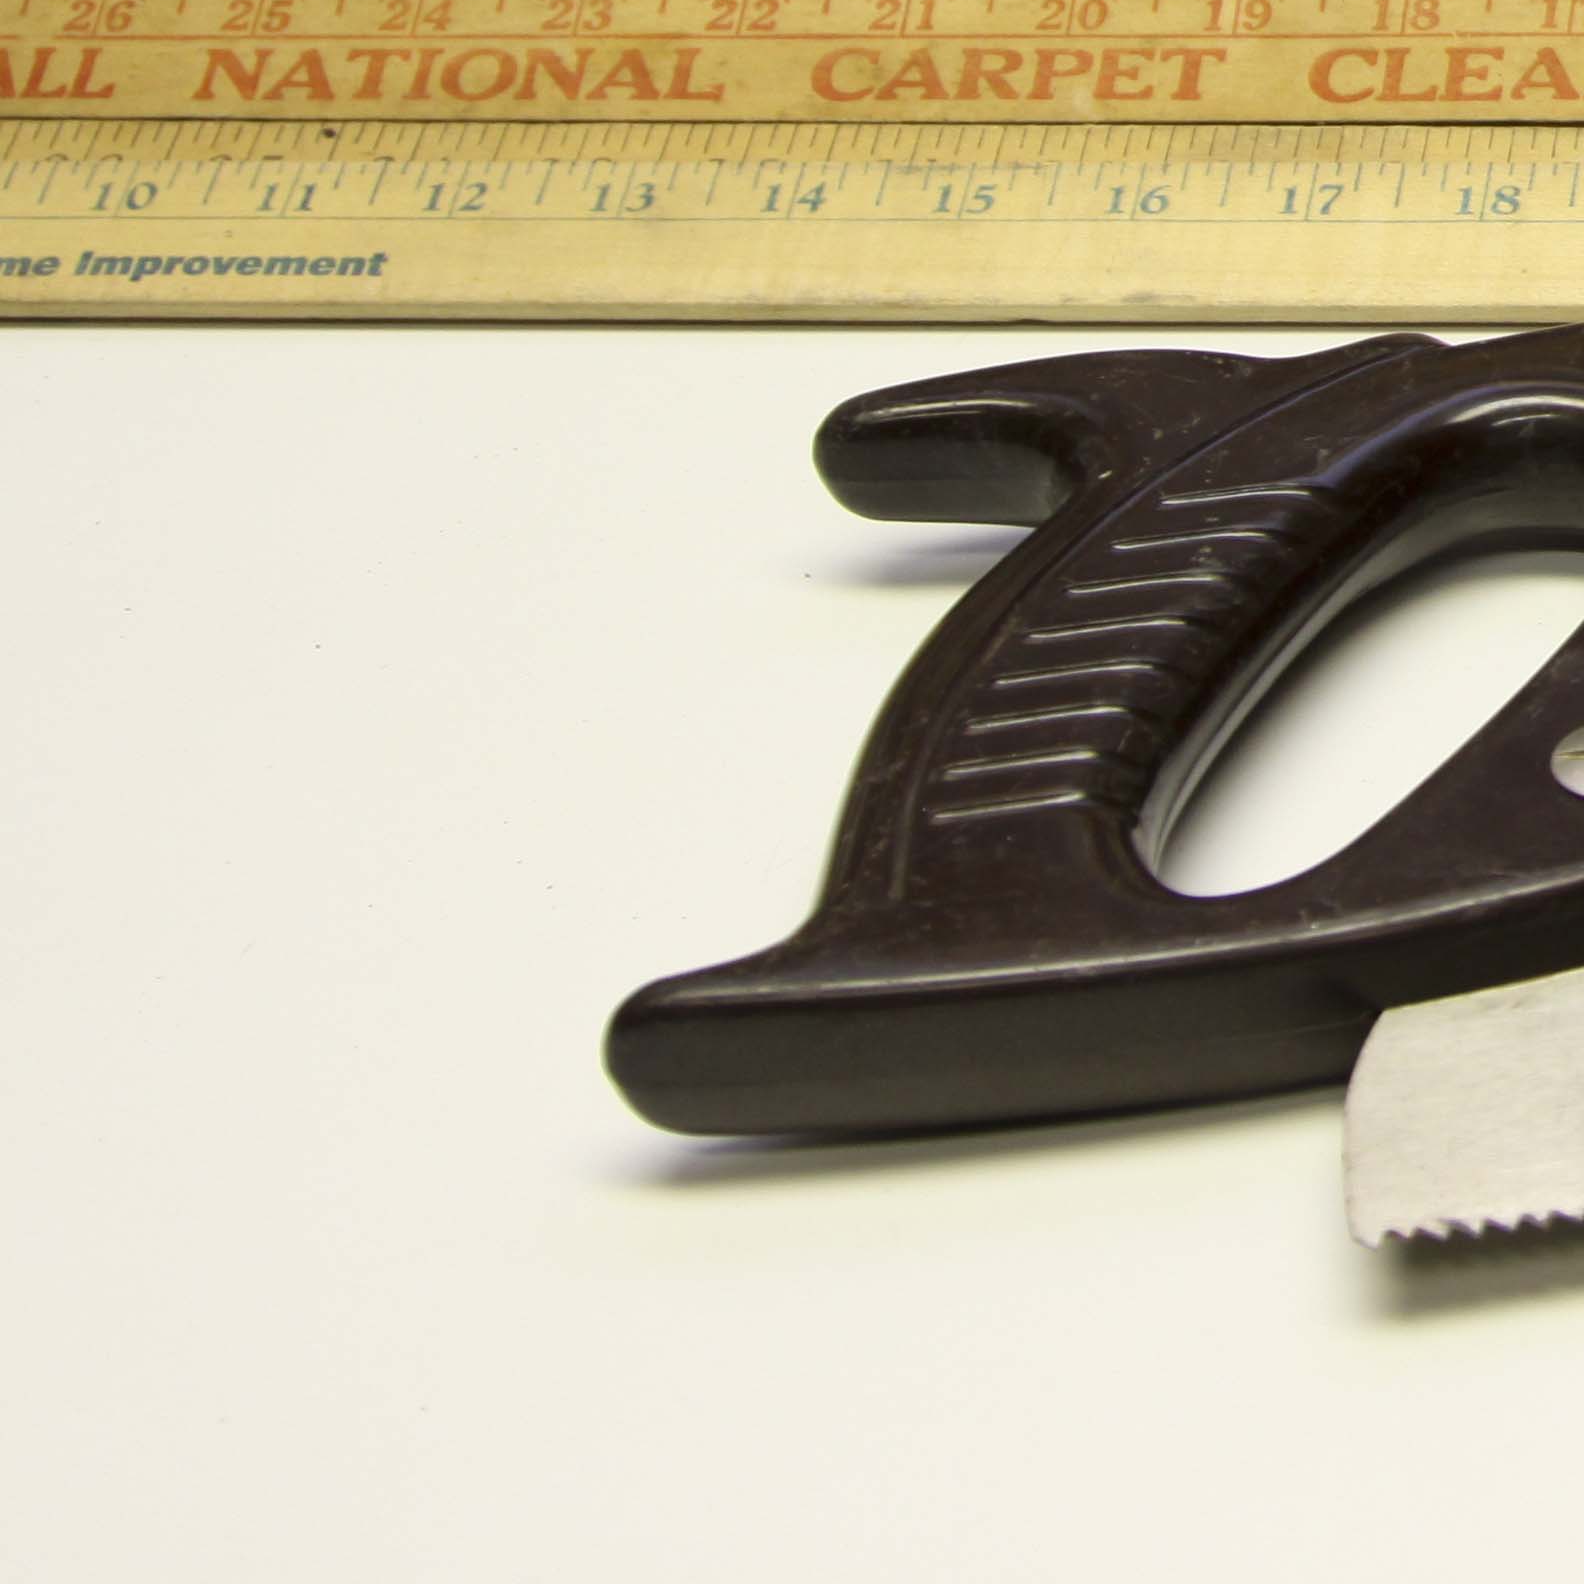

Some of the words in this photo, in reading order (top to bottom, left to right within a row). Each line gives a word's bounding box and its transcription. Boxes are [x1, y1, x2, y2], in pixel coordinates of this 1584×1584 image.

[69, 0, 134, 32] 26
[224, 0, 292, 32] 25
[380, 0, 453, 30] 24
[542, 0, 611, 31] 23
[706, 0, 779, 30] 22
[868, 0, 935, 30] 21
[192, 47, 725, 102] NATIONAL
[811, 47, 1227, 101] CARPET
[94, 182, 156, 211] 10
[258, 183, 314, 210] 11
[424, 183, 486, 211] 12
[592, 183, 655, 211] 13
[761, 184, 827, 212] 14
[933, 184, 996, 213] 15
[1107, 185, 1170, 213] 16
[1281, 185, 1344, 213] 17
[1456, 185, 1520, 214] 18
[74, 251, 388, 282] Improvement
